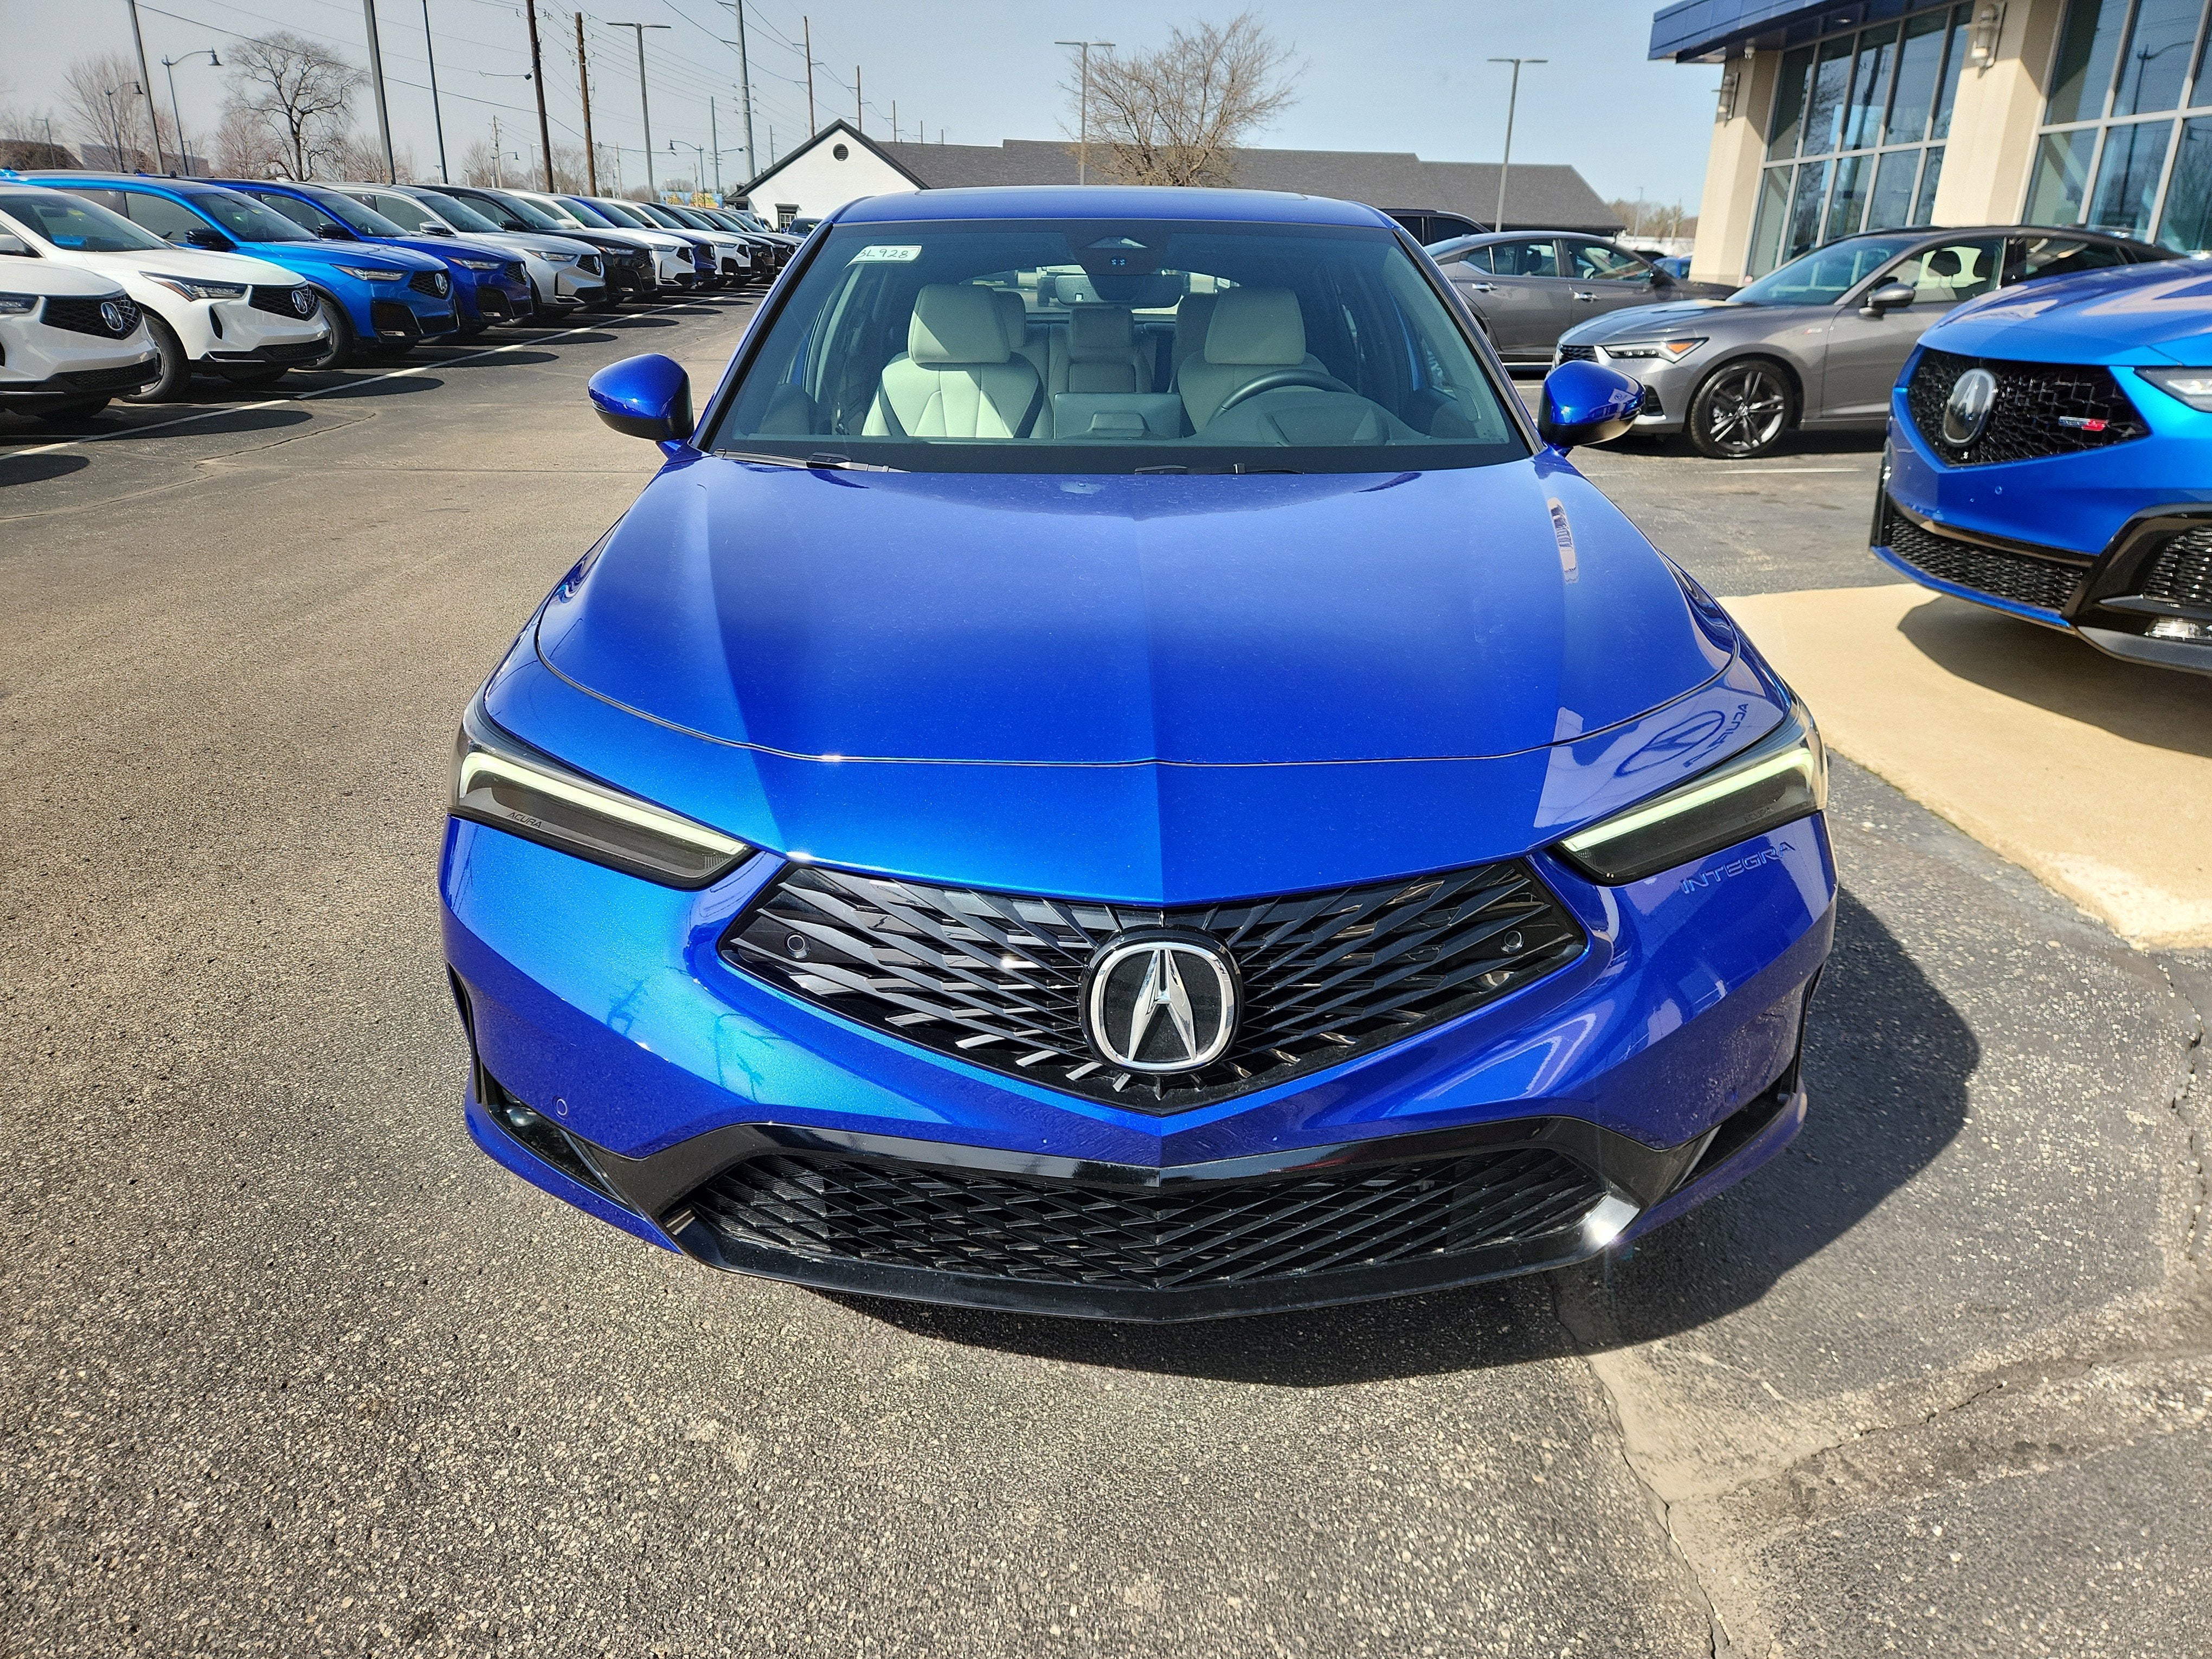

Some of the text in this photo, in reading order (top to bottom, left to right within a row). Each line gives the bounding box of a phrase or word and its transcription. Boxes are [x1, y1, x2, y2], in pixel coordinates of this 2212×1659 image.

[879, 248, 908, 259] 928
[506, 812, 542, 828] ACURA
[1681, 841, 1796, 894] INTEGRA
